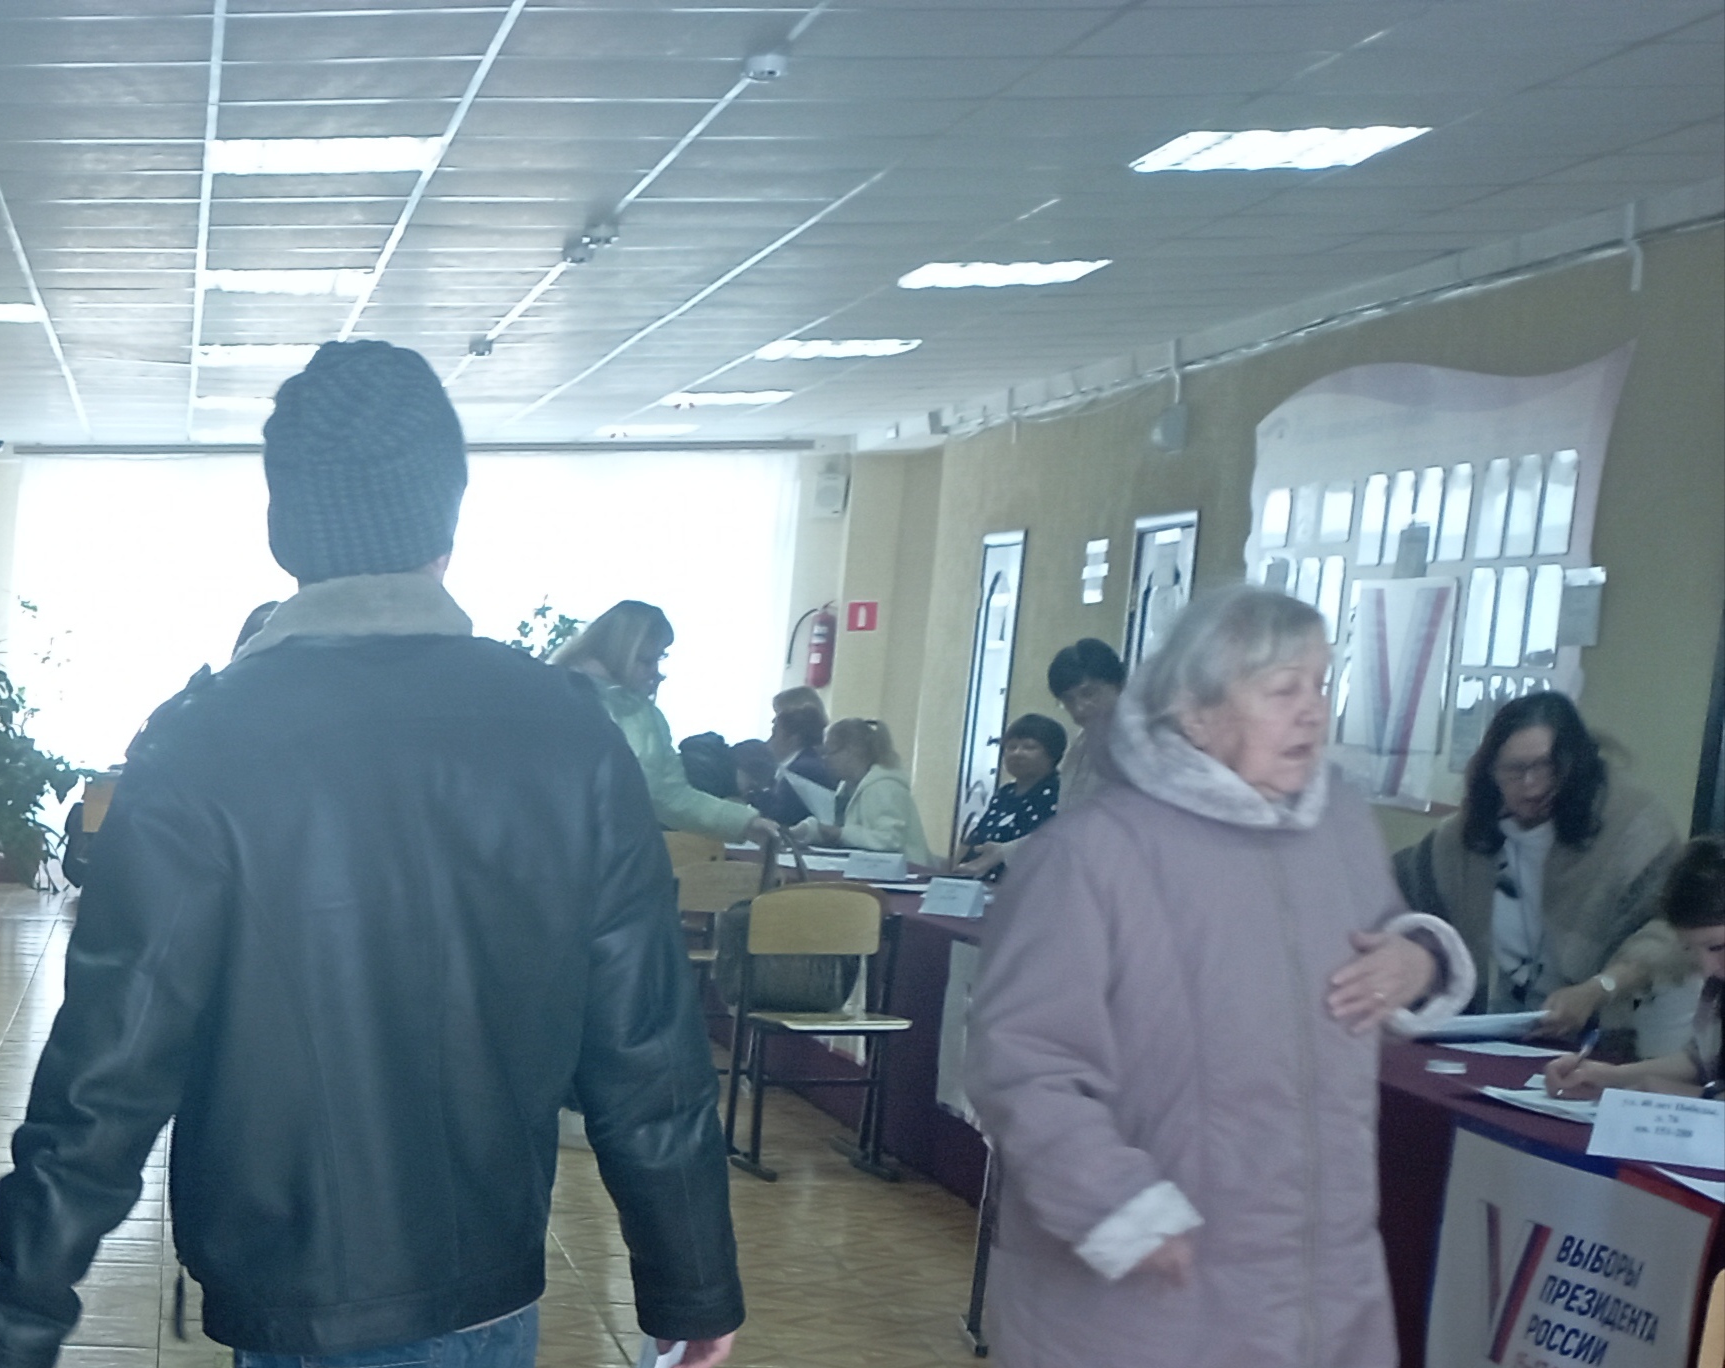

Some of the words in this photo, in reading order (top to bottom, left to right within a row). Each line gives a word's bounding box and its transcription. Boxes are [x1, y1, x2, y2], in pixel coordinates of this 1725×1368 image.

[1556, 1235, 1645, 1288] ВЫБОРЫ
[1539, 1275, 1660, 1345] ПРЕЗИДЕНТА
[1524, 1314, 1610, 1366] РОССИИ
